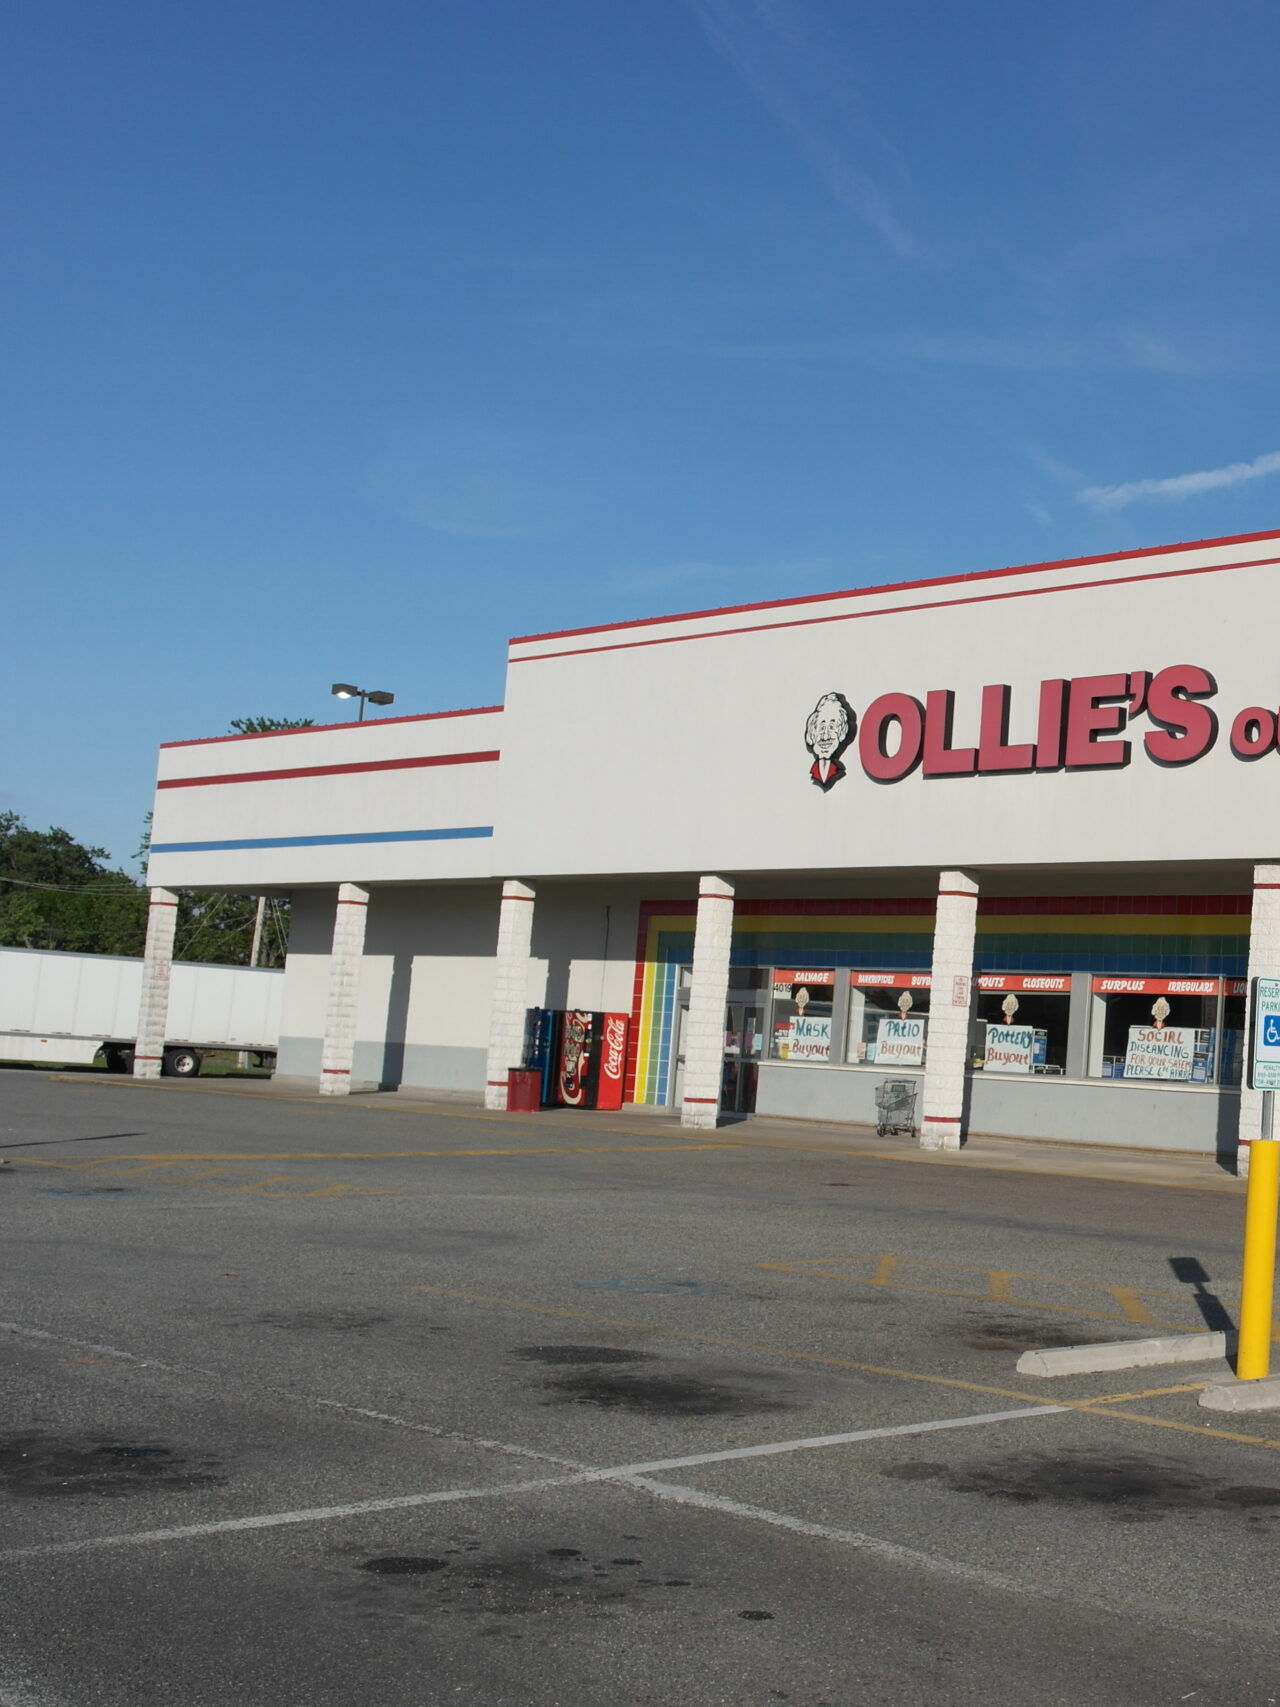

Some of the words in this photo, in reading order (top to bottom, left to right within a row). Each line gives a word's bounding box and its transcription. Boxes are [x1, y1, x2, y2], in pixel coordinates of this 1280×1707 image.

[858, 664, 1217, 783] OLLIE'S
[794, 972, 829, 982] SALVAGE
[858, 974, 895, 985] BANKRUPTCIES
[1022, 978, 1064, 989] CLOSEOUTS
[1100, 980, 1145, 991] SURPLUS
[1167, 981, 1214, 993] IRREGULARS
[796, 1018, 830, 1039] MASK
[1138, 1030, 1184, 1044] SOCIAL
[604, 1016, 625, 1079] Coca-Cola
[792, 1039, 831, 1057] Buyout
[879, 1041, 921, 1058] Buyout
[985, 1048, 1029, 1065] Buyout
[1130, 1053, 1146, 1064] FOR
[1126, 1063, 1154, 1076] PLEASE
